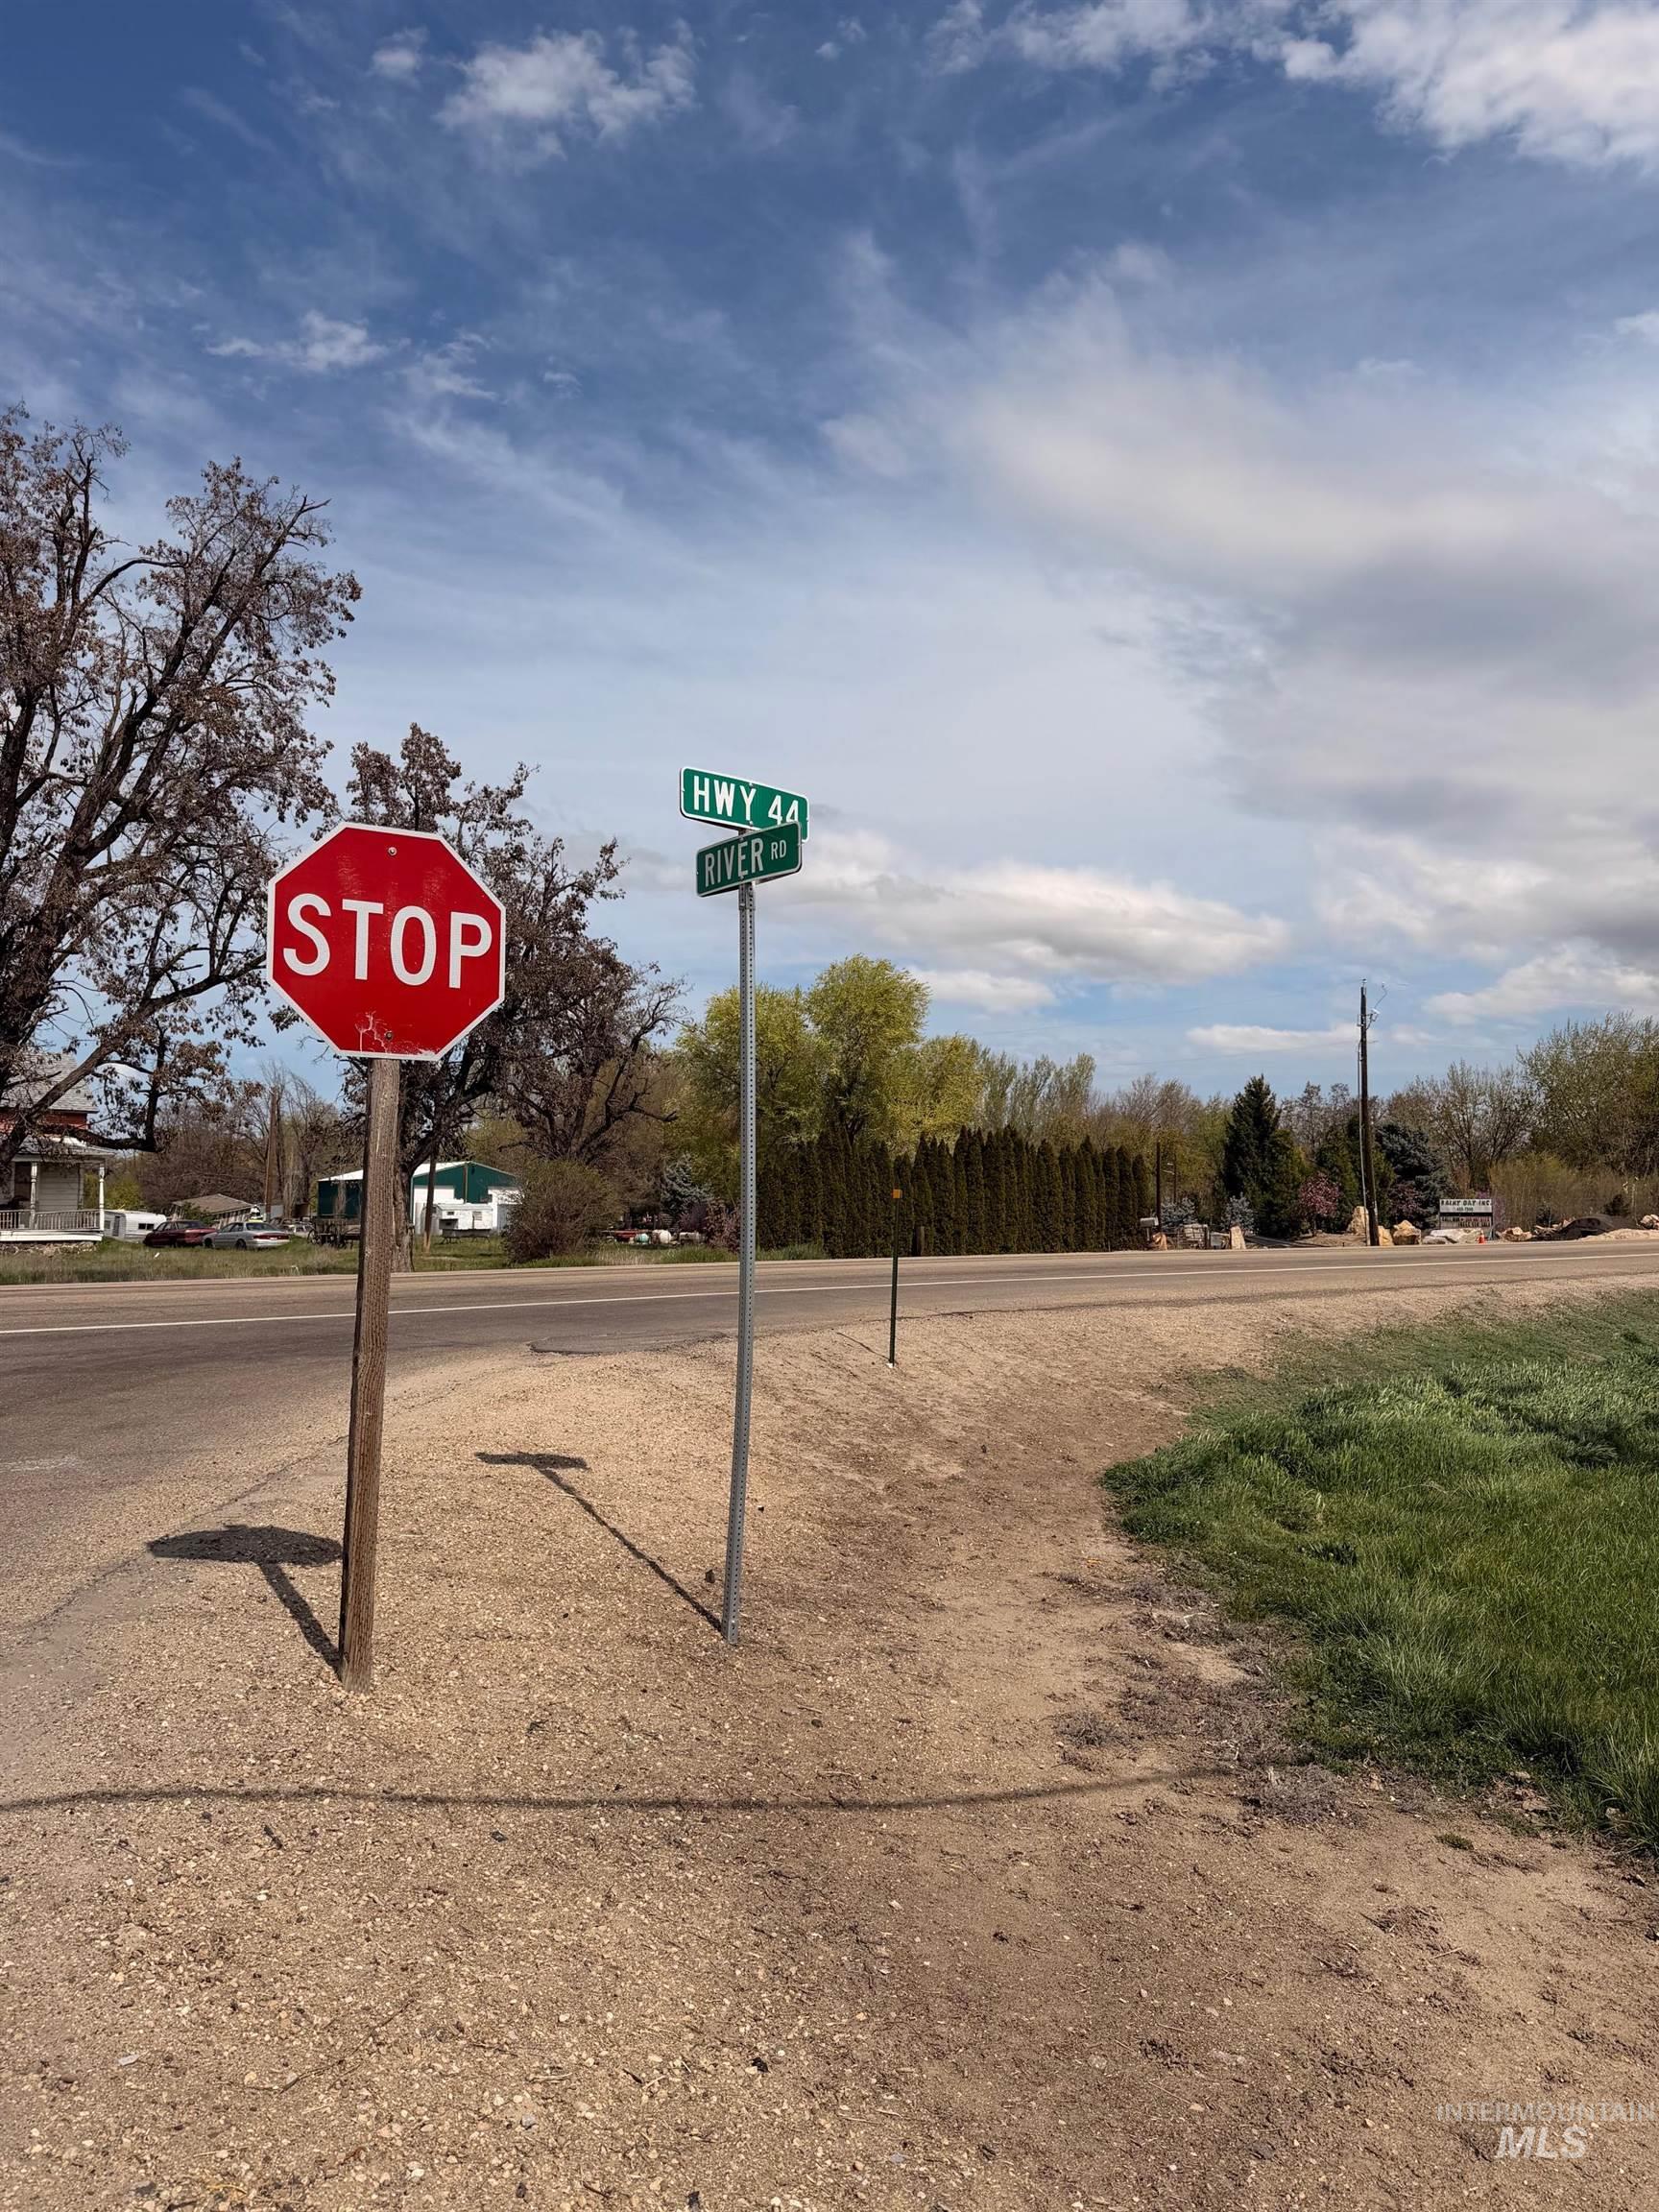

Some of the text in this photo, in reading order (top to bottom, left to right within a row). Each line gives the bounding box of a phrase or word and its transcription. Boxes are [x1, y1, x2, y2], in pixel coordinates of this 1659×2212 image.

[693, 775, 799, 826] HWY 44
[704, 837, 787, 888] RIVER RD
[282, 892, 493, 989] STOP
